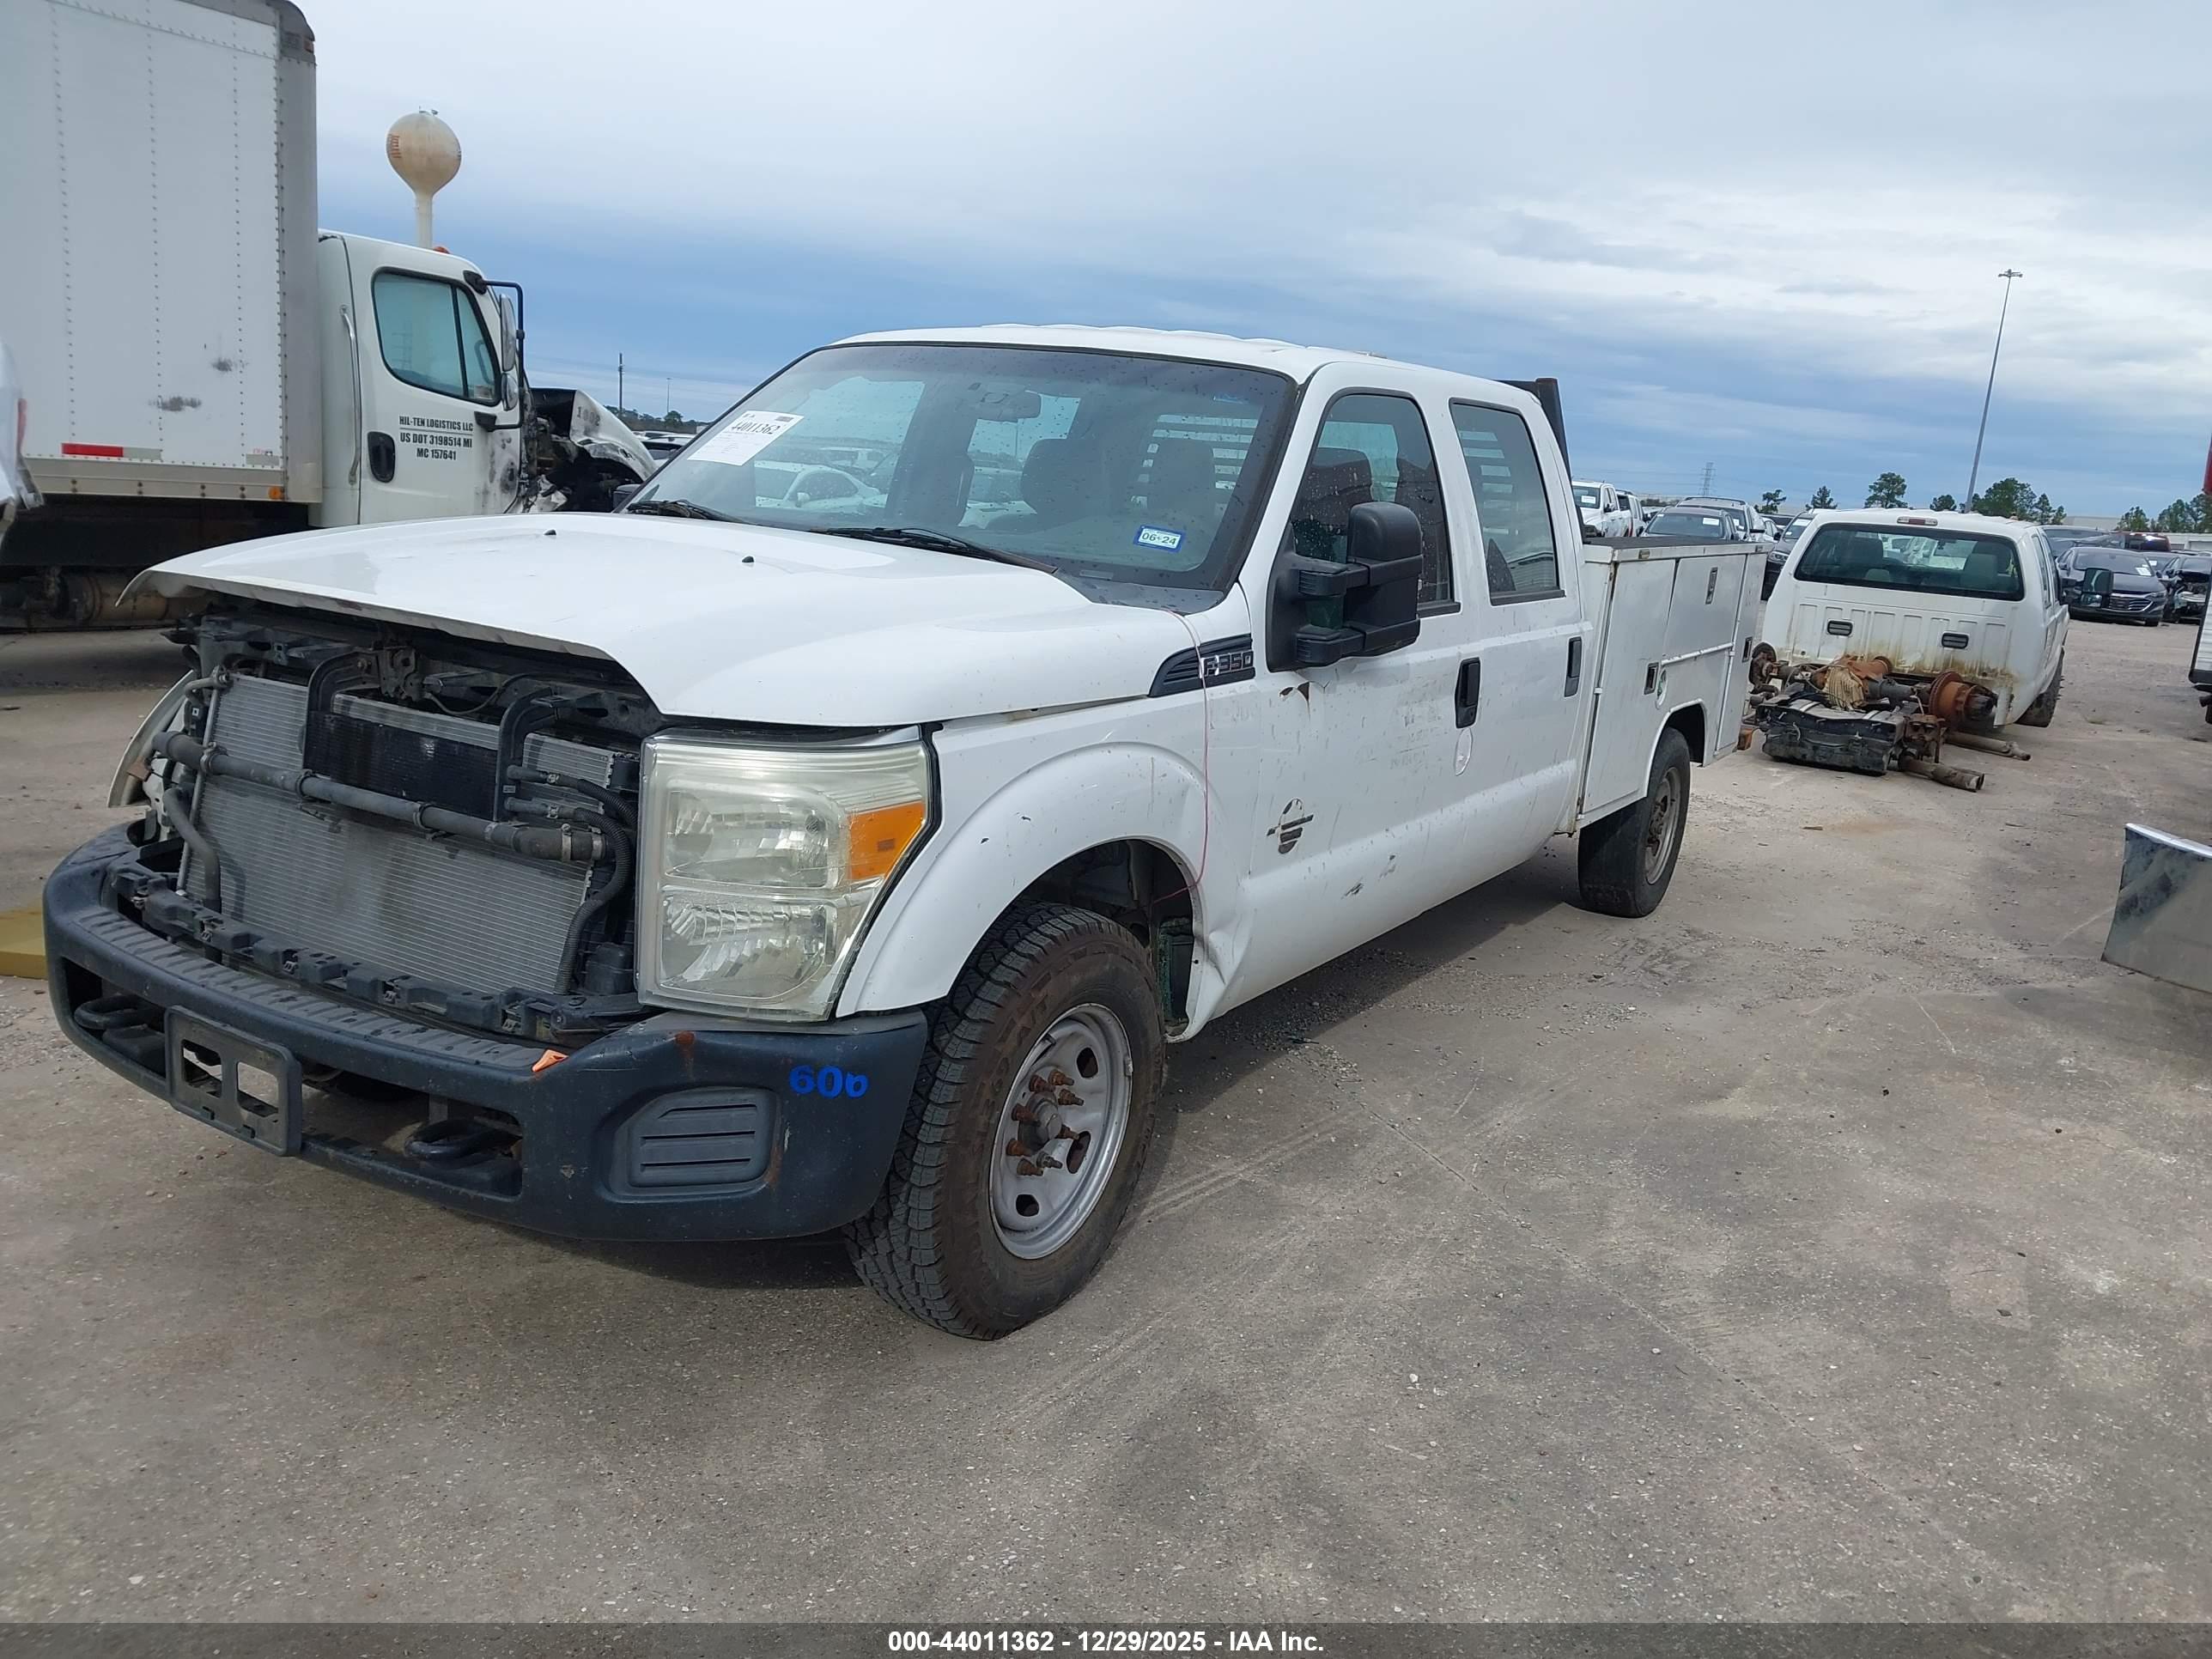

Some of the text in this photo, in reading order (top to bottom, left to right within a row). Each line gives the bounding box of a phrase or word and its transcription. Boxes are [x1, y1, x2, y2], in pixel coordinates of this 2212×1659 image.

[427, 418, 461, 430] LOGISTICS
[462, 422, 474, 431] LLC
[400, 432, 473, 448] US DOT 3198514 MI
[416, 447, 457, 461] MC 157641
